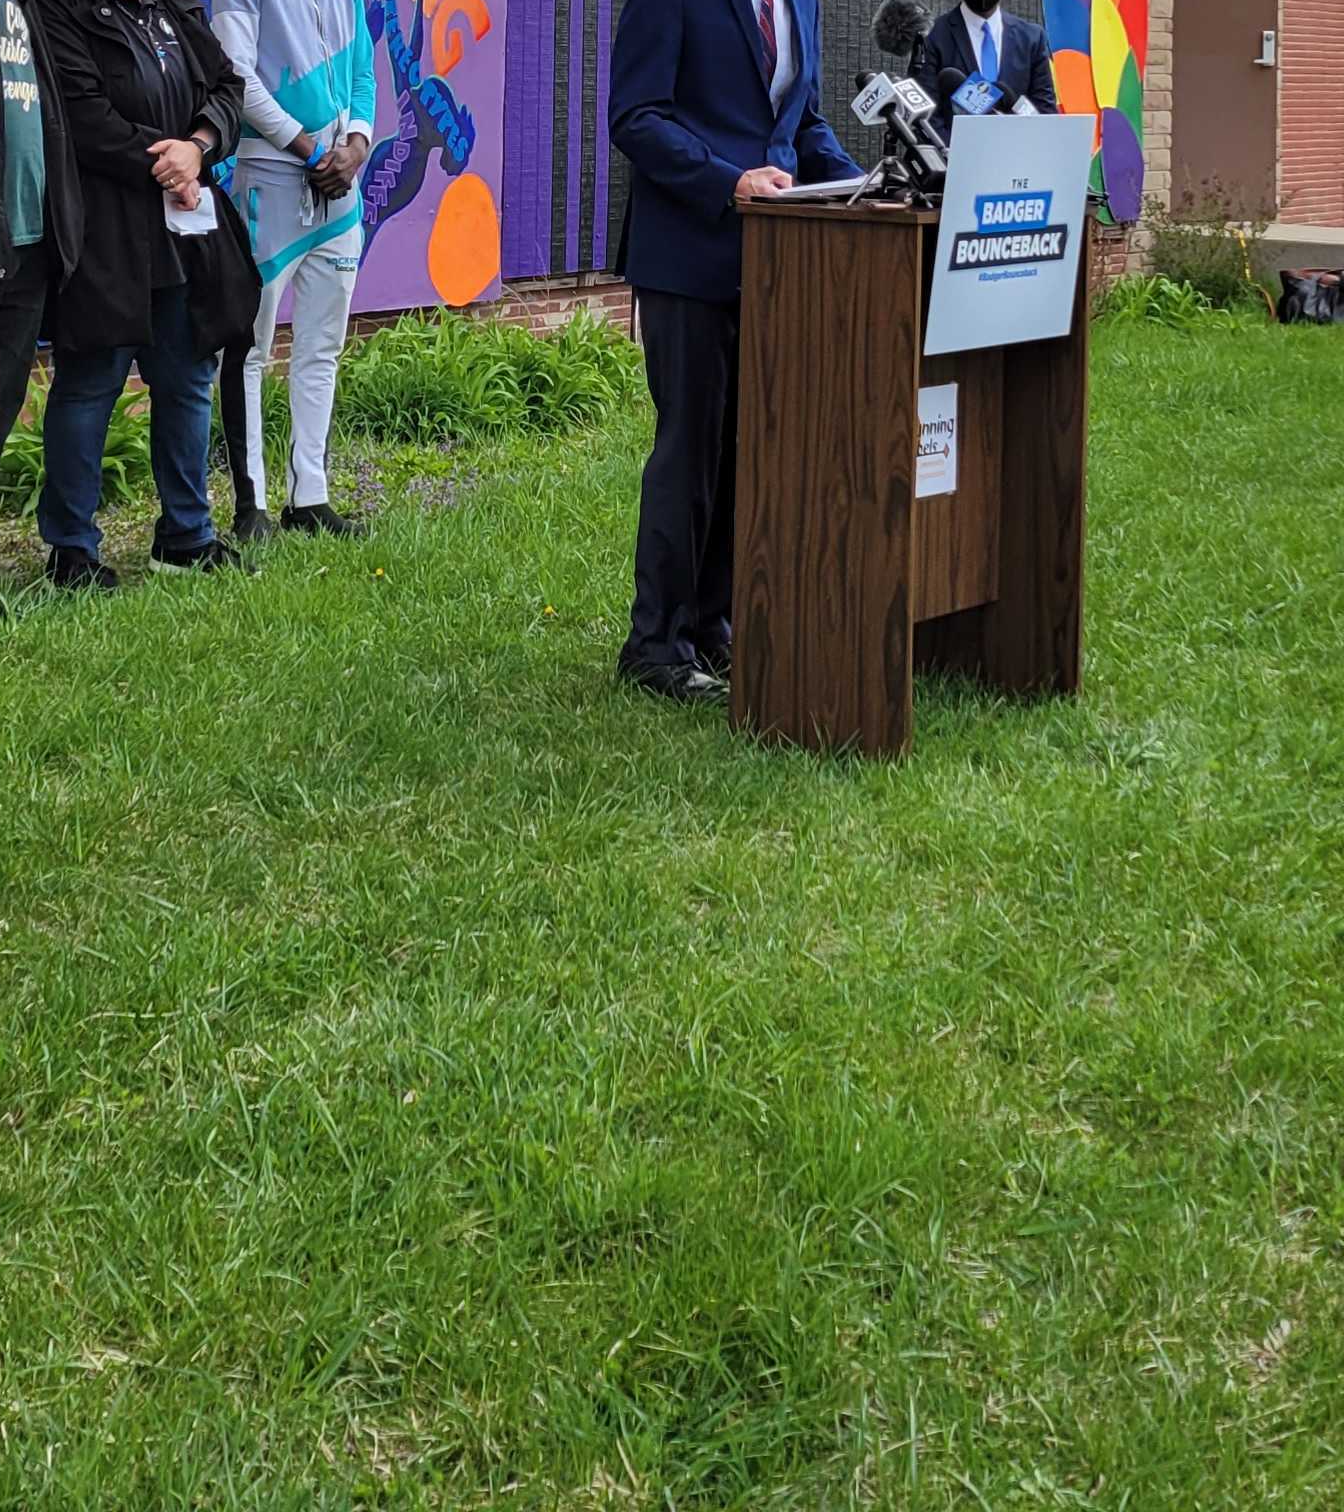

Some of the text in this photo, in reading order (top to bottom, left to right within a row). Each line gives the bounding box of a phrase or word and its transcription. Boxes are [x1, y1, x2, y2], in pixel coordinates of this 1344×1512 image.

[1011, 178, 1030, 189] THE
[981, 198, 1046, 225] BADGER
[956, 231, 1062, 264] BOUNCEBACK
